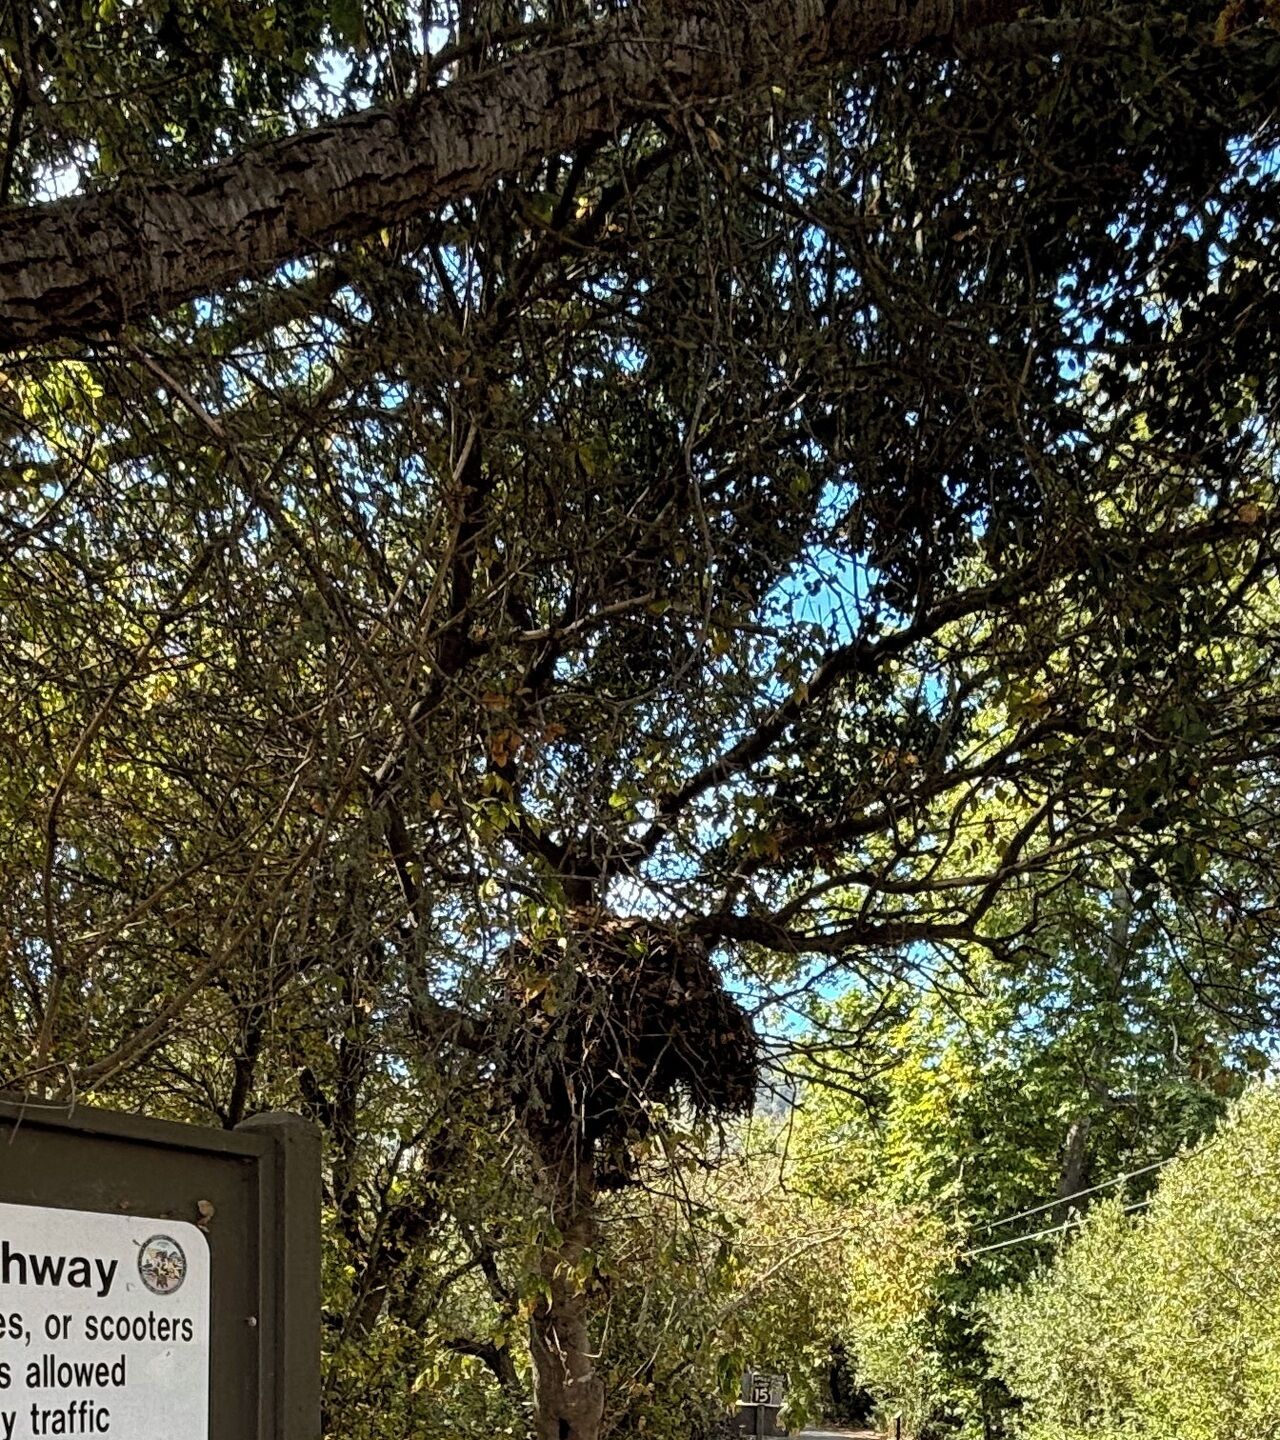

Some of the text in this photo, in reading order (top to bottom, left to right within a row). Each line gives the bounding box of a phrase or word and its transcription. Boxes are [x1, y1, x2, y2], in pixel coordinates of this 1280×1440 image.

[44, 1314, 72, 1340] or
[85, 1310, 193, 1342] scooters
[25, 1353, 126, 1389] allowed
[755, 1388, 769, 1402] 15
[30, 1400, 110, 1435] traffic
